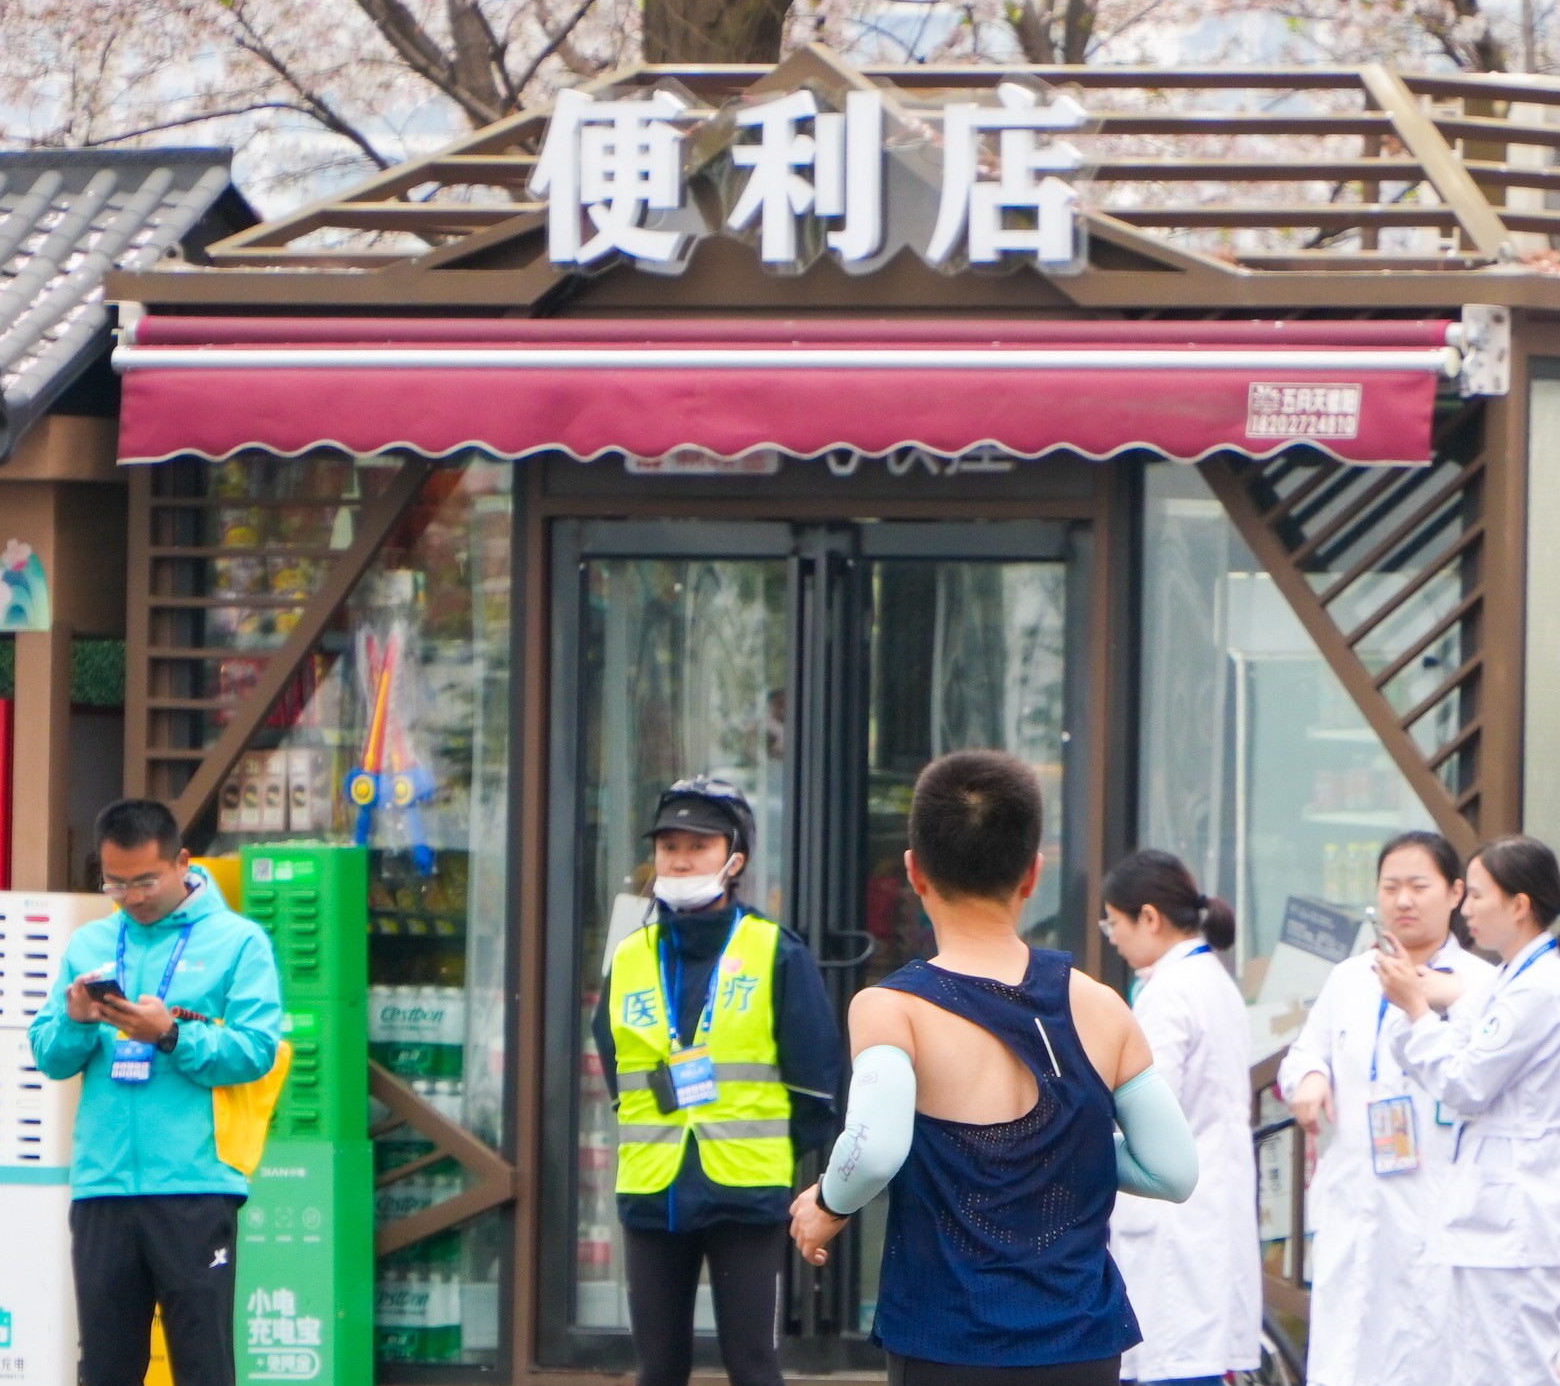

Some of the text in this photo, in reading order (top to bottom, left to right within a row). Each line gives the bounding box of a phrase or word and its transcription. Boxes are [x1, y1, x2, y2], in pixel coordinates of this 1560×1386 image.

[529, 82, 1087, 268] 便利店
[624, 974, 759, 1028] 医 疗
[247, 1287, 296, 1316] 小电
[247, 1316, 322, 1346] 充电宝
